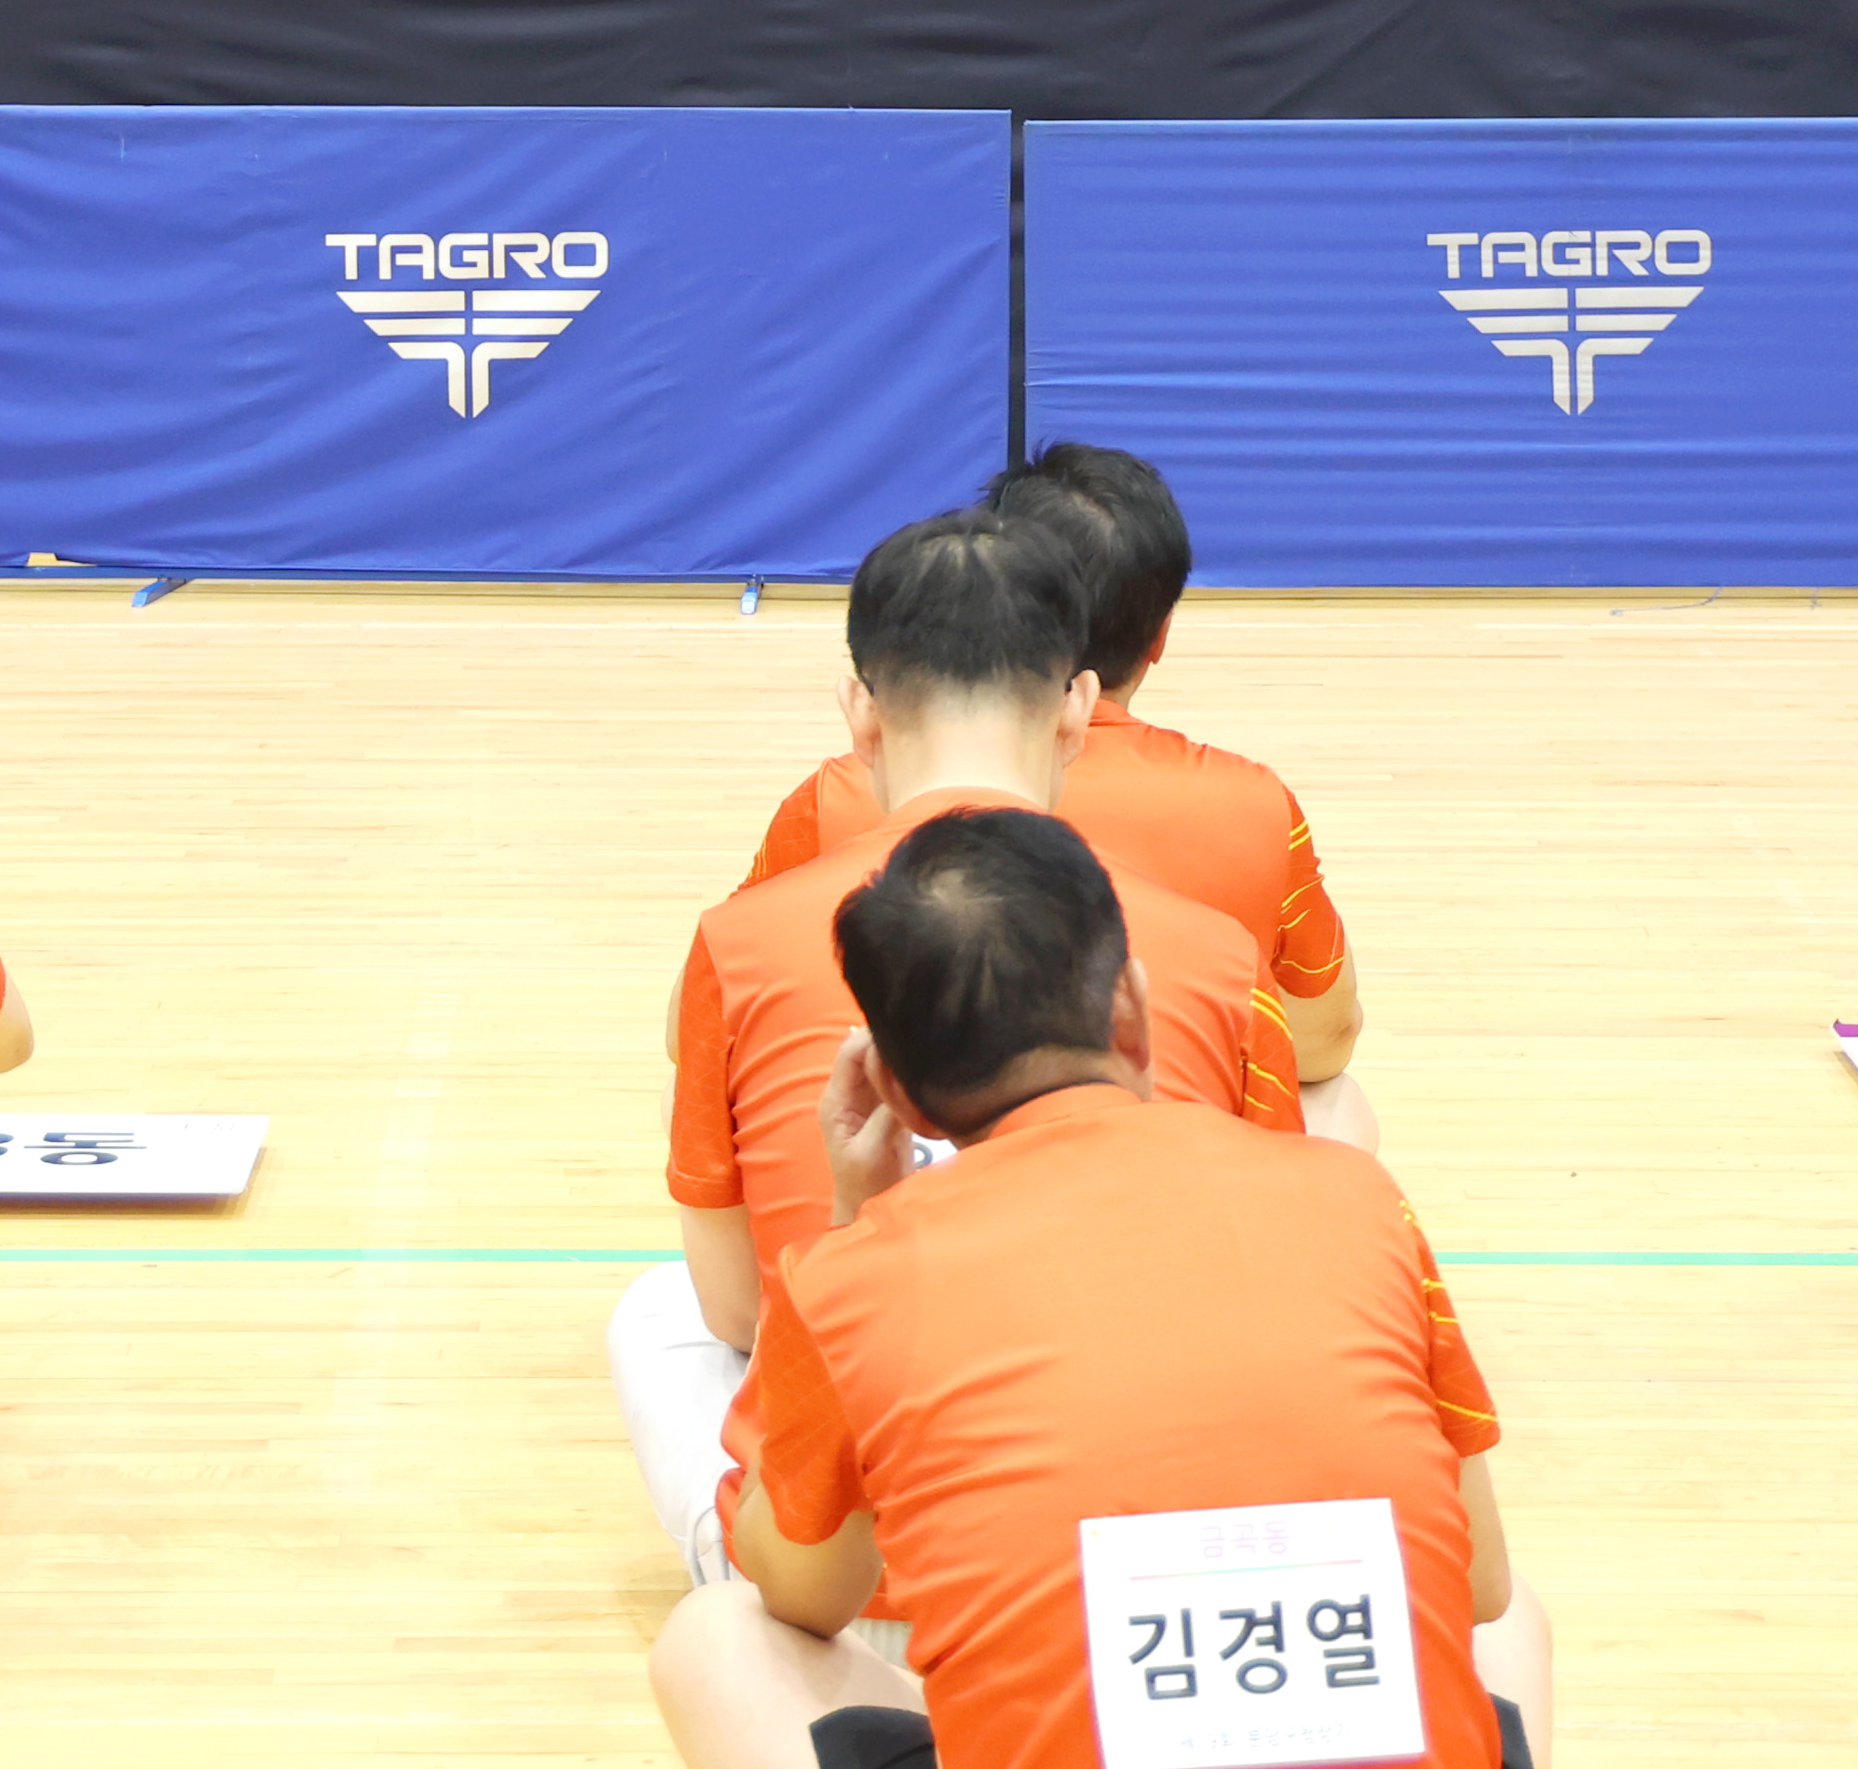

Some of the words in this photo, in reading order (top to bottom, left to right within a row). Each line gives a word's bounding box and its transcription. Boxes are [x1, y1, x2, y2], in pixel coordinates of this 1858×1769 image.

[325, 230, 610, 280] TAGRO
[1426, 229, 1713, 279] TAGRO
[1198, 1520, 1291, 1559] 금곡동
[1127, 1593, 1382, 1701] 김경열
